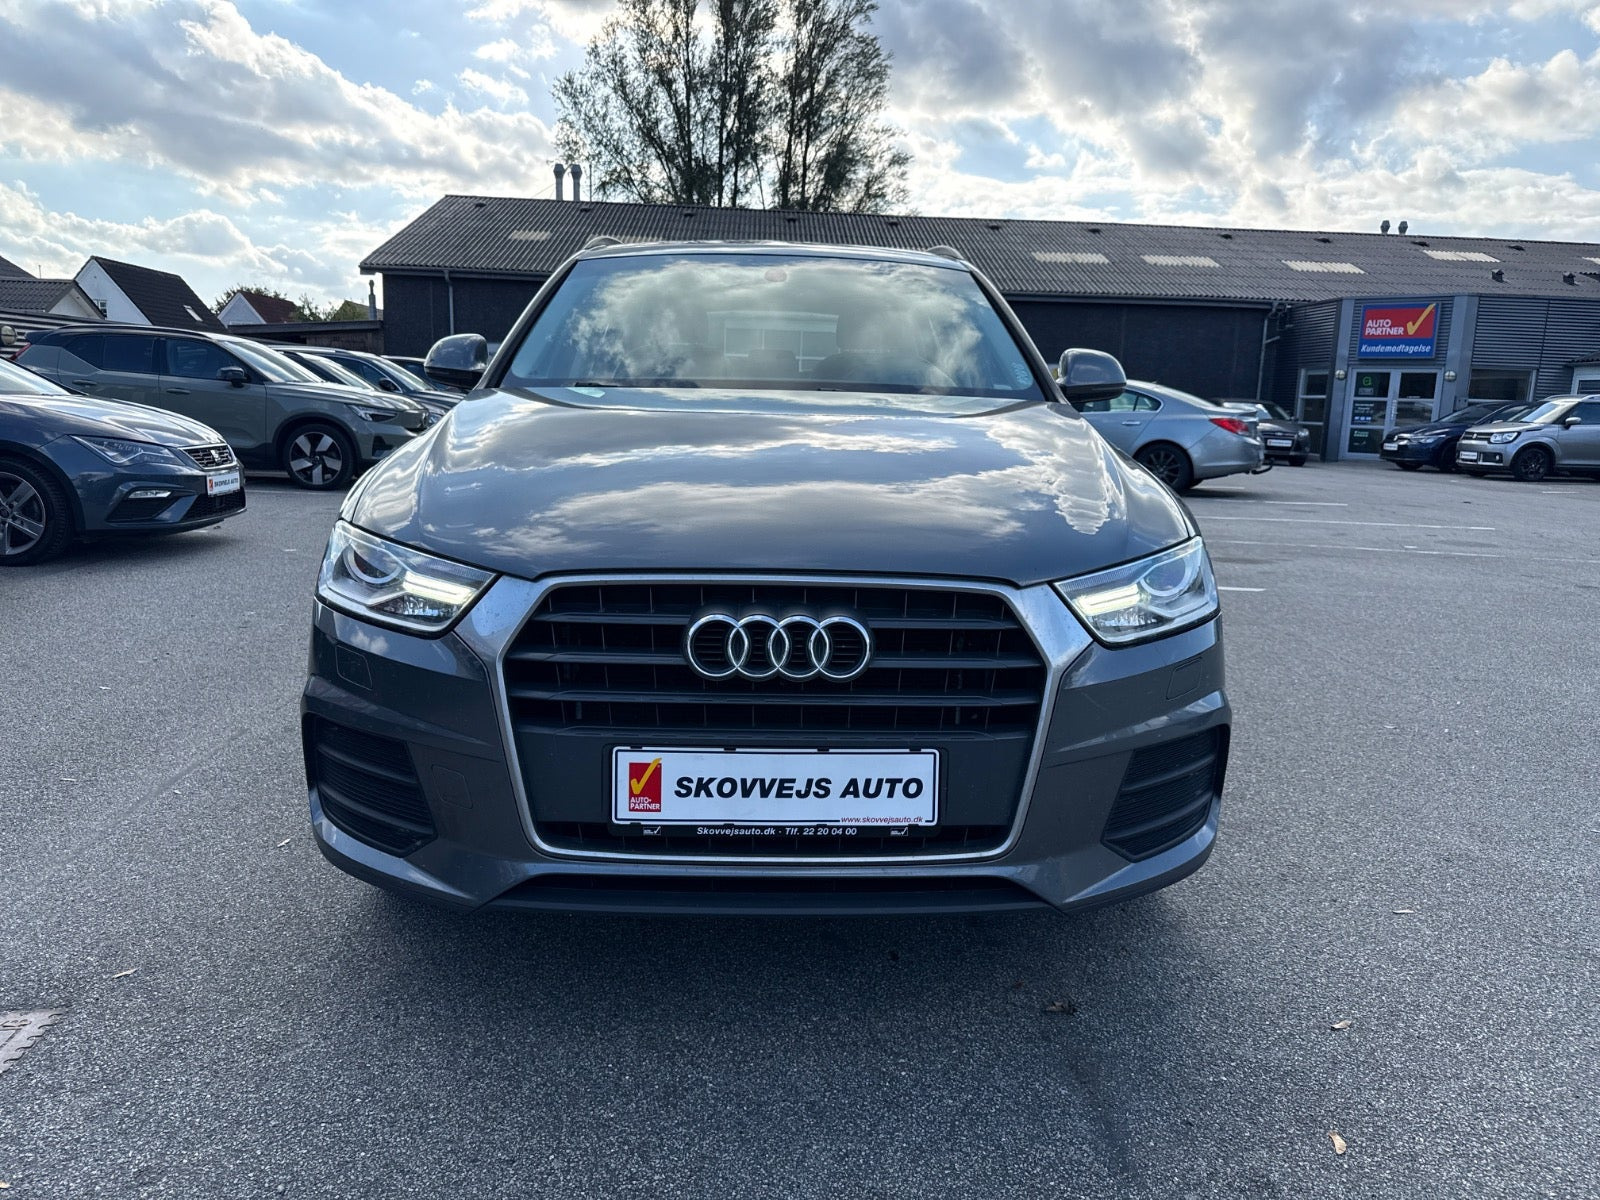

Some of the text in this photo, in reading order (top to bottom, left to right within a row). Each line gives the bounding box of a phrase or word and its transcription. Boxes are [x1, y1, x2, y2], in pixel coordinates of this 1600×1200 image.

[1366, 319, 1391, 327] AUTO
[1365, 327, 1404, 336] PARTNER
[1361, 344, 1431, 354] Kundemodtagelse
[674, 776, 924, 799] SKOVVEJS AUTO
[630, 803, 661, 811] PARTNER
[840, 815, 923, 825] www.skovvejsauto.dk
[696, 826, 776, 837] Skovvejsauto.dk
[785, 827, 800, 835] Tlf.
[802, 827, 815, 836] 22
[817, 827, 829, 836] 20
[831, 827, 842, 836] 04
[845, 827, 857, 836] 00
